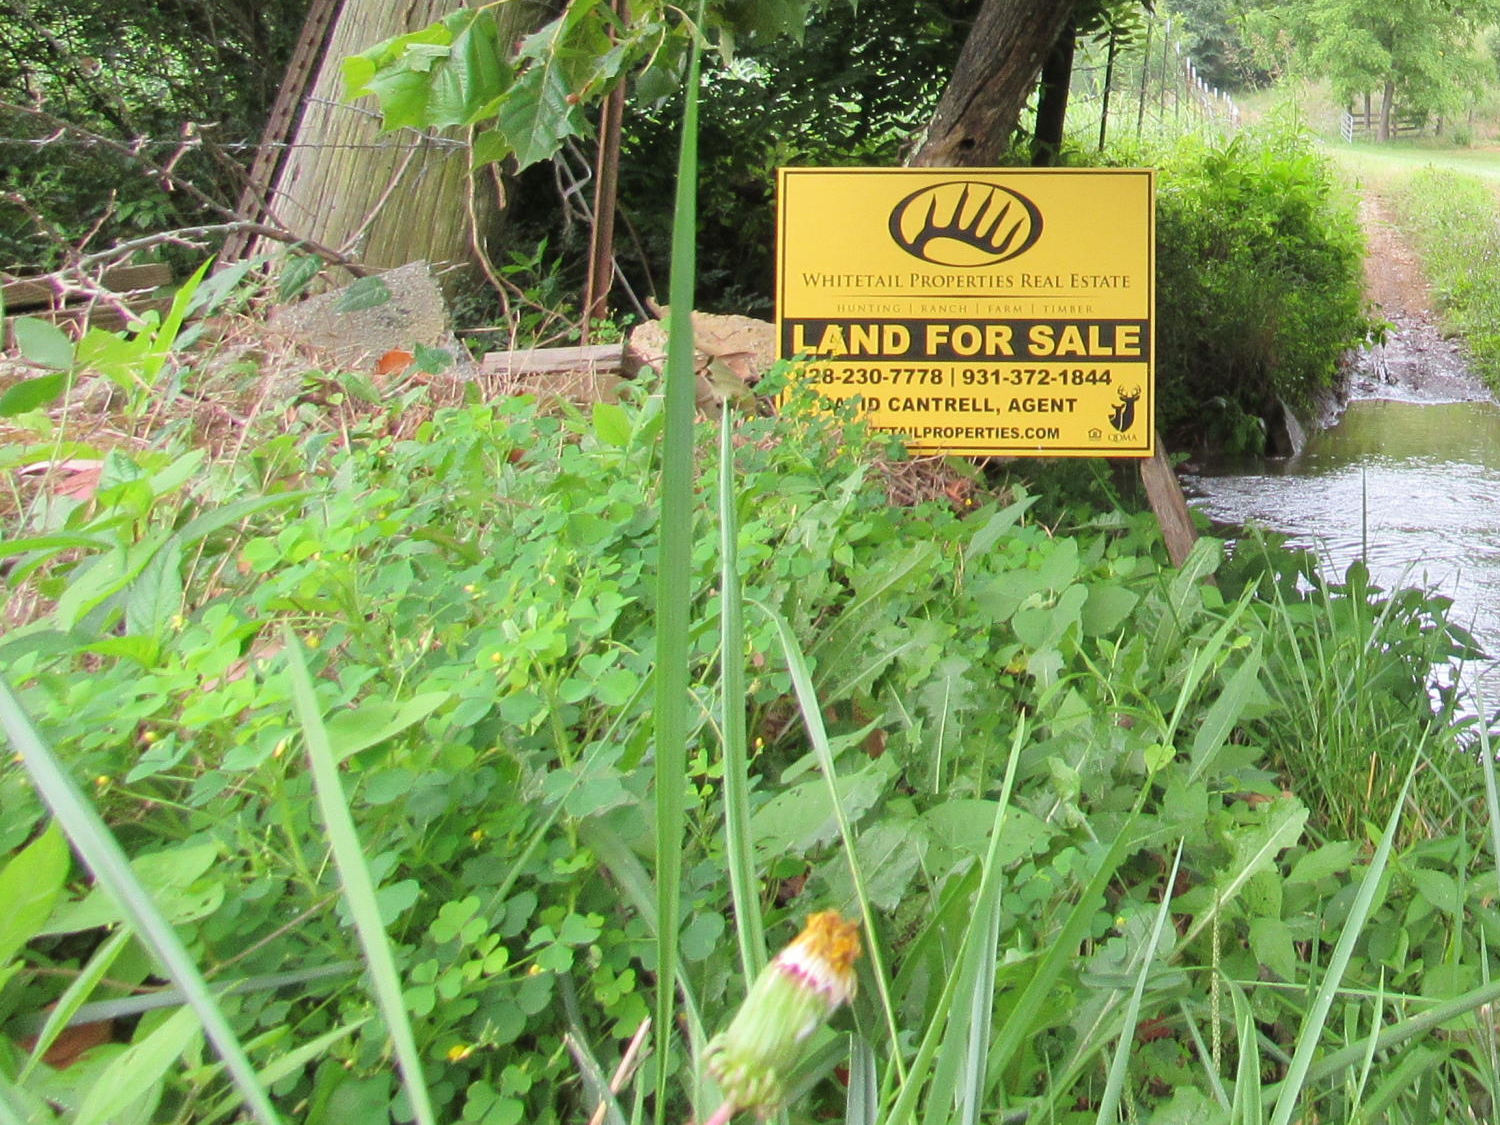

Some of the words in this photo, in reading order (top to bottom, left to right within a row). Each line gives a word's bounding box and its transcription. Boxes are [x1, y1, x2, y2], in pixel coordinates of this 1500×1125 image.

[803, 272, 903, 288] WHITETAIL
[910, 272, 1013, 288] PROPERTIES
[1020, 272, 1064, 288] REAL
[1071, 272, 1131, 288] ESTATE
[837, 304, 901, 313] HUNTING
[921, 304, 968, 313] RANCH
[987, 305, 1023, 314] FARM
[1043, 305, 1094, 314] TIMBER
[793, 325, 910, 356] LAND
[926, 325, 1012, 355] FOR
[1028, 325, 1141, 355] SALE
[804, 369, 943, 385] 28-230-7778
[962, 369, 1112, 385] 931-372-1844
[888, 397, 1001, 414] CANTRELL,
[1009, 398, 1077, 413] AGENT
